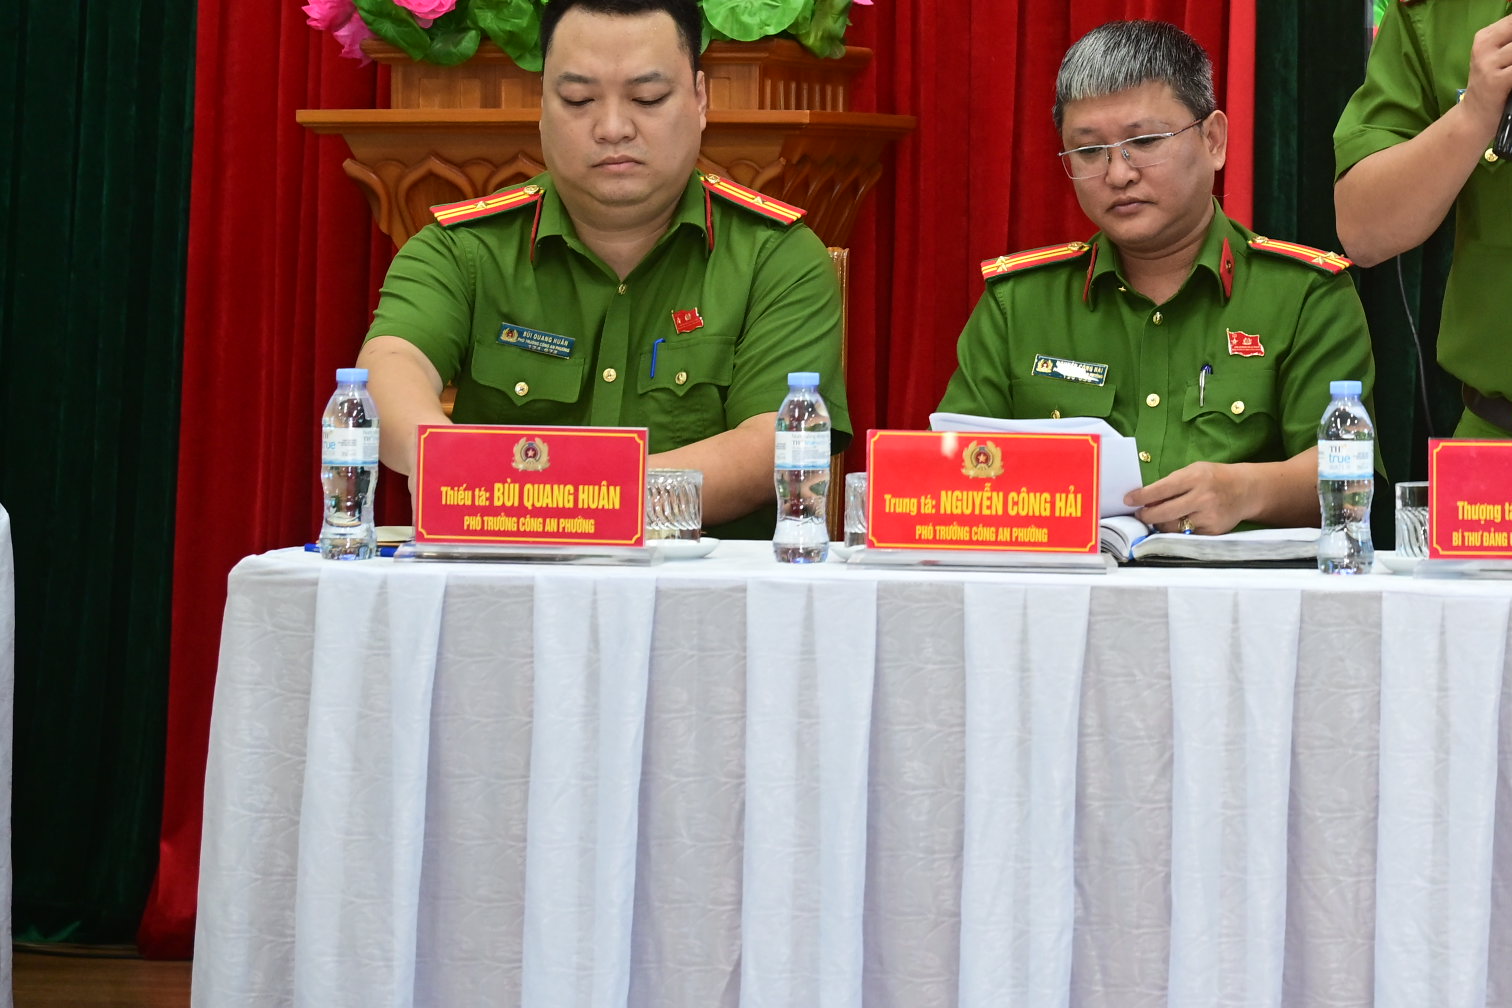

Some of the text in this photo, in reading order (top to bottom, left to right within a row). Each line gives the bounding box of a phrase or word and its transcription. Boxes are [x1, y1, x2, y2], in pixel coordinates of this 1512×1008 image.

[1328, 453, 1351, 463] true
[440, 483, 472, 506] Thiếu
[474, 486, 490, 506] tá:
[523, 482, 574, 510] QUANG
[578, 480, 621, 510] HUÂN
[884, 483, 1082, 517] Trung tá: NGUYỄN CÔNG HẢI
[464, 513, 482, 531] PHÓ
[483, 512, 517, 532] TRƯỞNG
[519, 515, 543, 532] CÔNG
[545, 518, 557, 533] AN
[1456, 500, 1502, 525] Thượng
[915, 523, 933, 540] PHÓ
[935, 521, 970, 541] TRƯỞNG
[971, 523, 996, 542] CÔNG
[997, 527, 1011, 542] AN
[1452, 529, 1462, 547] BÍ
[1464, 530, 1483, 547] THƯ
[1482, 527, 1508, 547] ĐẢNG
